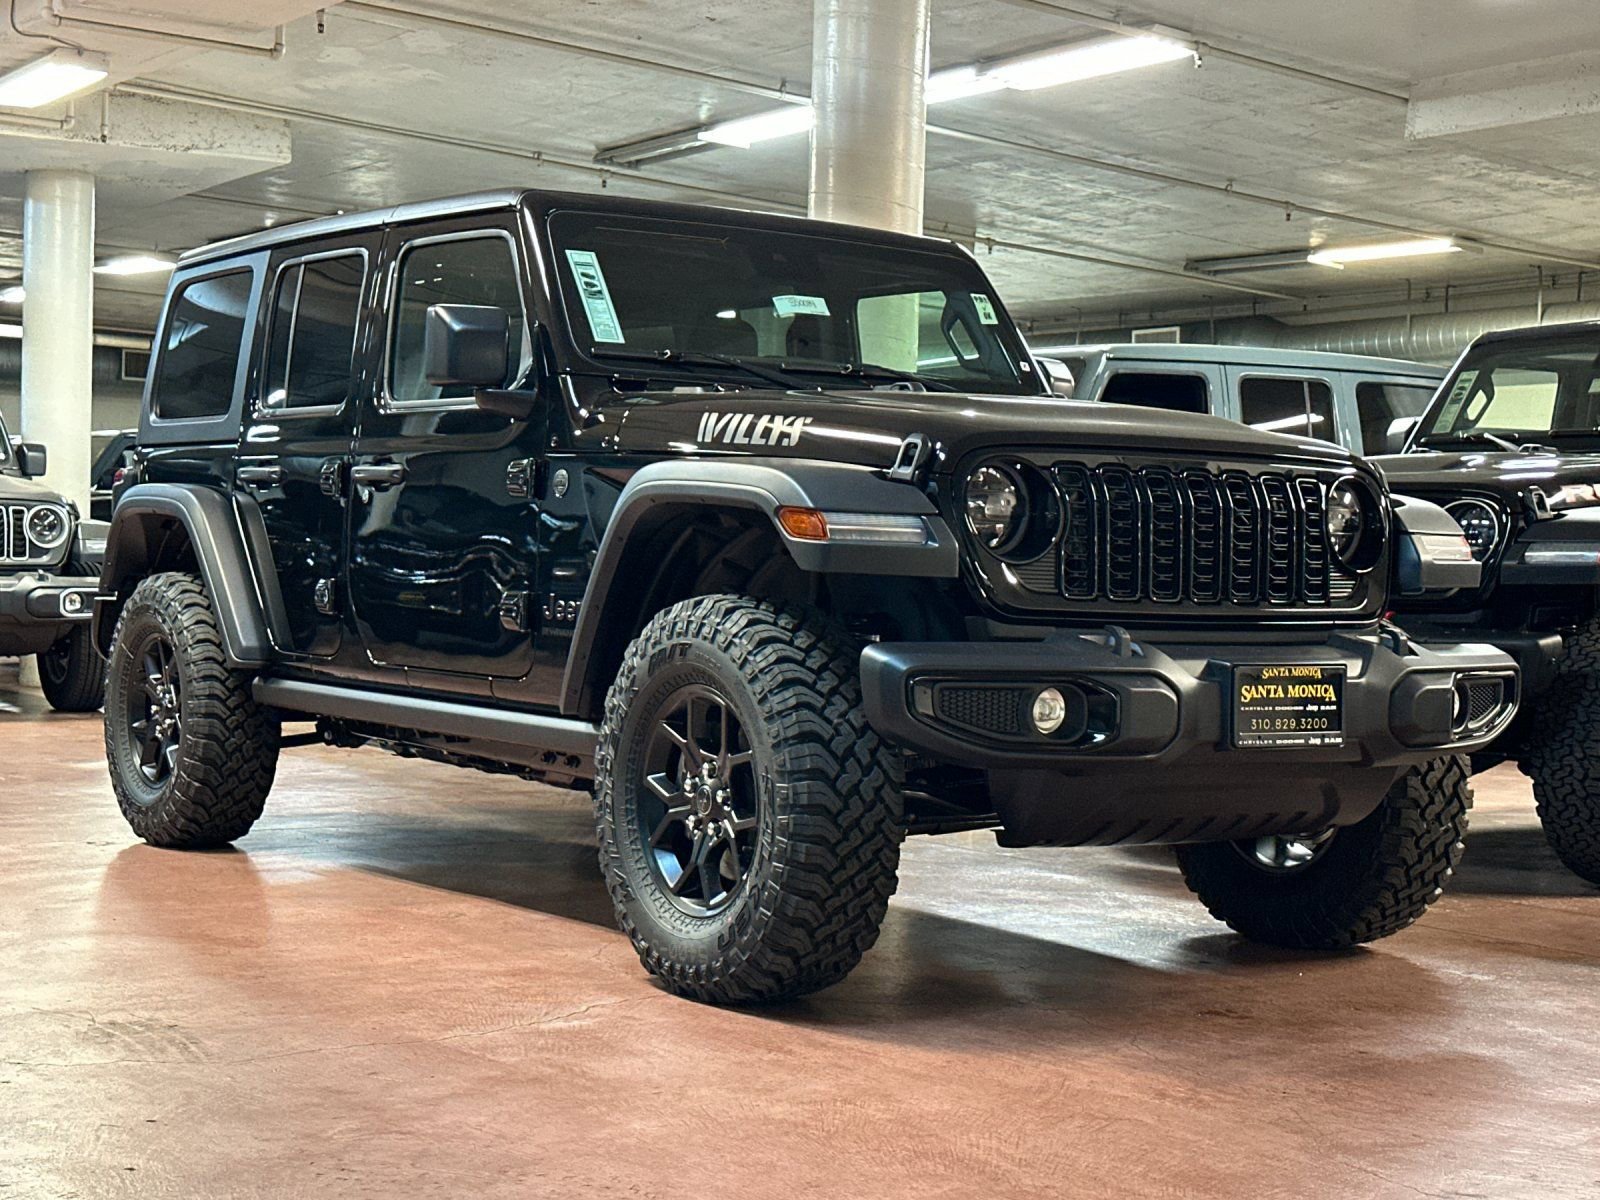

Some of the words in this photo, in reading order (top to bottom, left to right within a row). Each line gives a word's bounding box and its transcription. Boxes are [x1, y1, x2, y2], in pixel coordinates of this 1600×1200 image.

[697, 412, 813, 447] WILLYS
[1262, 667, 1289, 680] SANTA
[1291, 667, 1322, 679] MONICA
[1241, 685, 1285, 702] SANTA
[1287, 684, 1336, 701] MONICA
[1251, 717, 1328, 730] 310.829.3200
